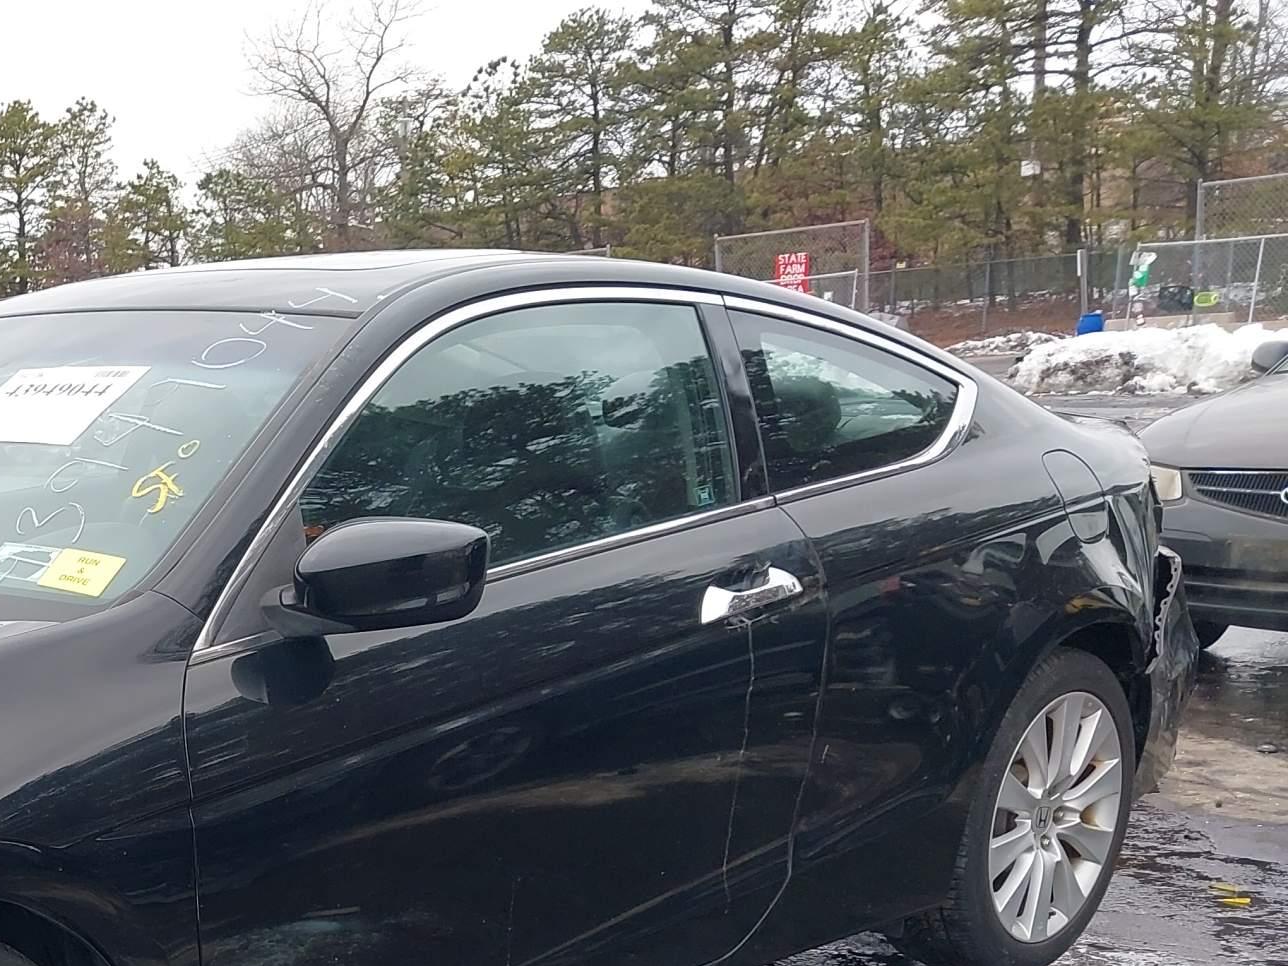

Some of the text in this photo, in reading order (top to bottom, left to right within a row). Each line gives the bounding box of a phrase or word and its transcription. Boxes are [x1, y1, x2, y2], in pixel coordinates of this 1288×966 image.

[778, 252, 807, 264] STATE
[779, 263, 806, 275] FARM
[77, 556, 101, 567] RUN
[58, 574, 91, 586] DRIVE
